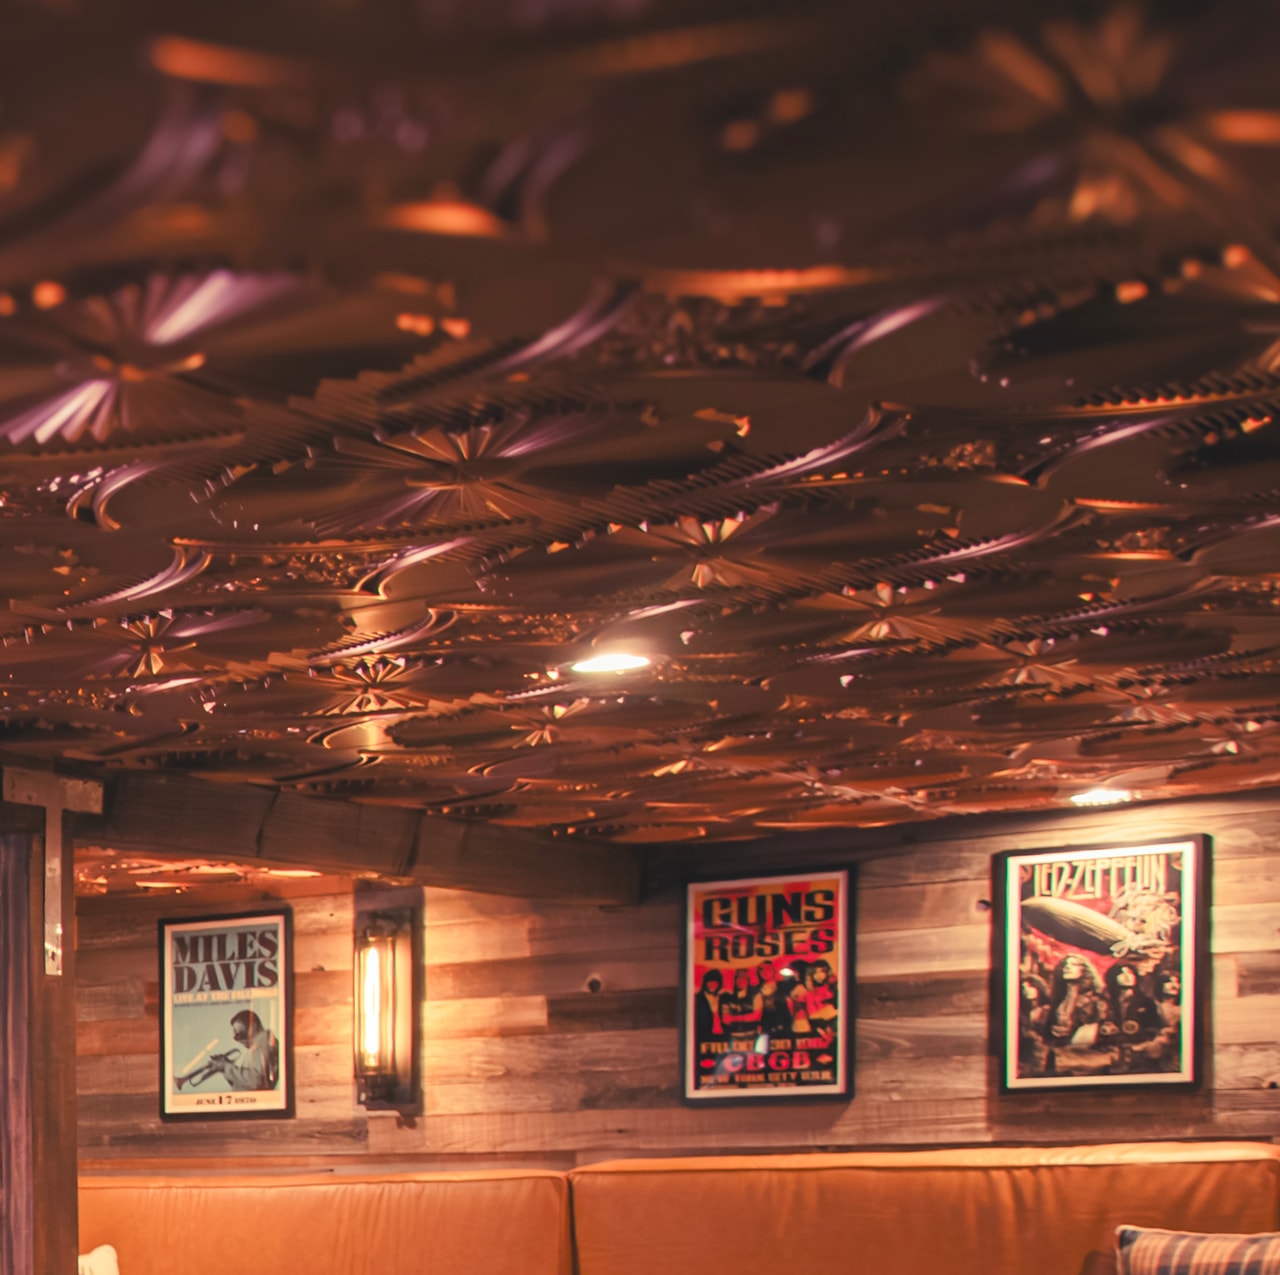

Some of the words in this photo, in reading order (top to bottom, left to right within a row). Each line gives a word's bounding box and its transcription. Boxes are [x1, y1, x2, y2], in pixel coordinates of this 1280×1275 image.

[703, 889, 835, 930] GUNS
[172, 929, 278, 964] MILES
[705, 929, 835, 962] ROSES
[173, 960, 279, 993] DAVIS
[722, 1051, 811, 1073] CBGB
